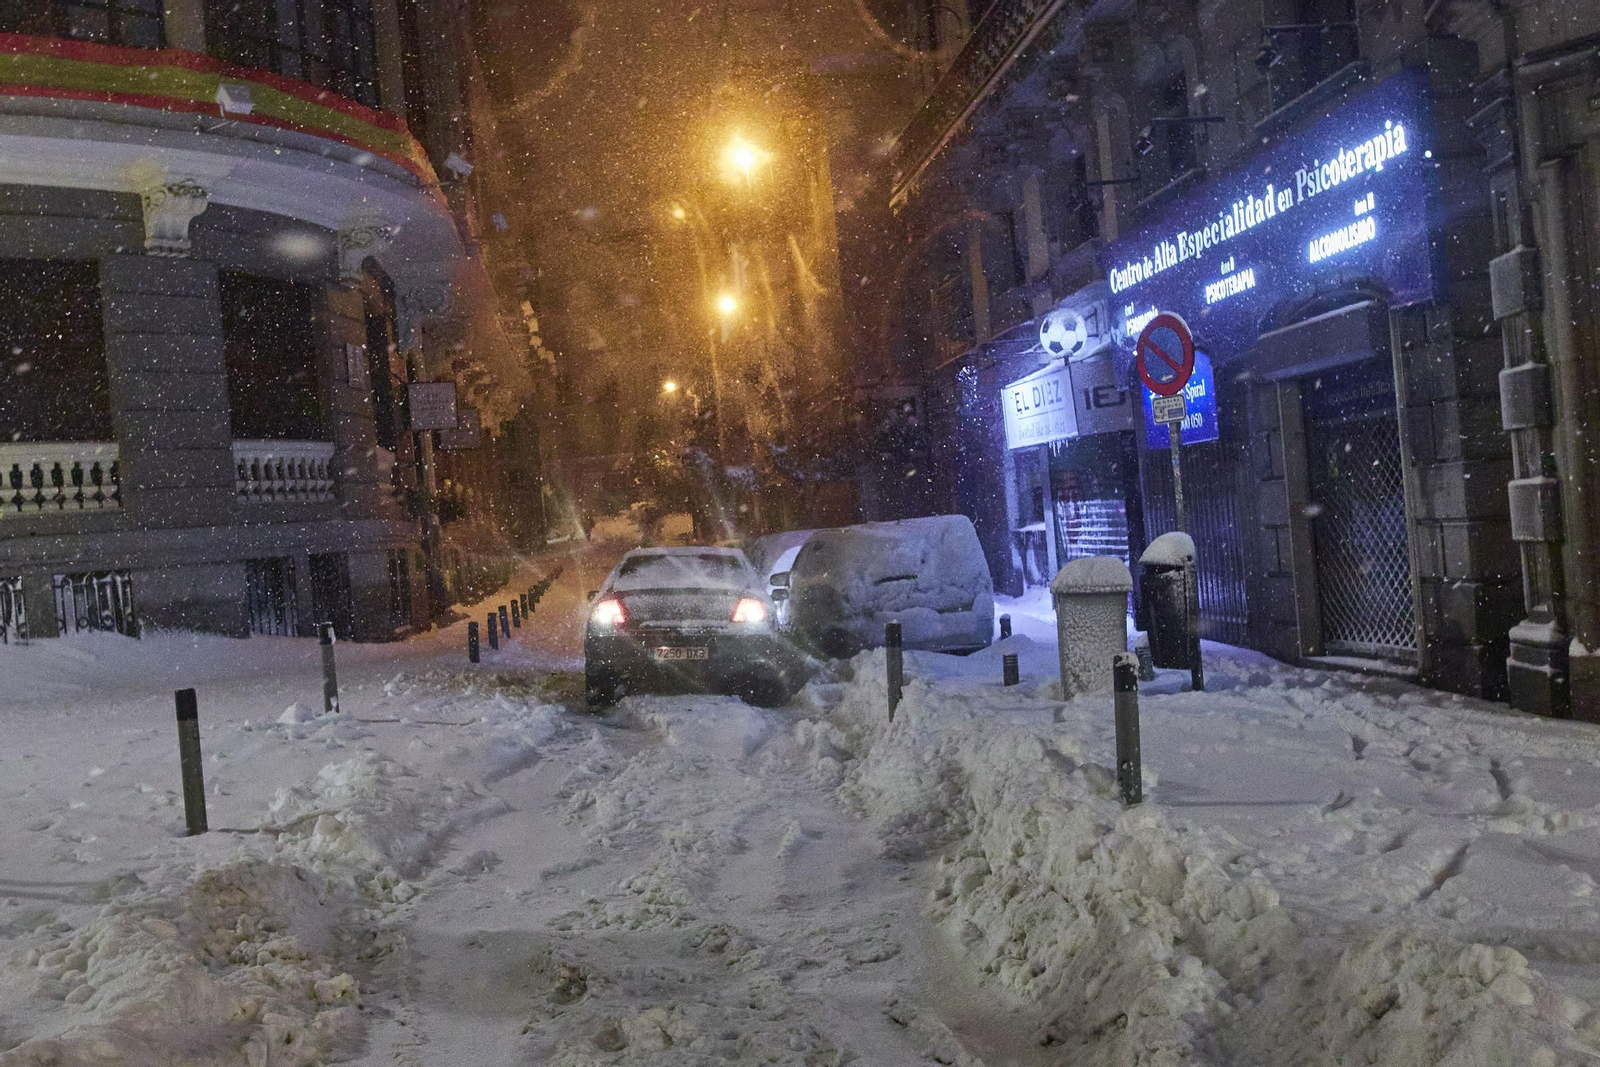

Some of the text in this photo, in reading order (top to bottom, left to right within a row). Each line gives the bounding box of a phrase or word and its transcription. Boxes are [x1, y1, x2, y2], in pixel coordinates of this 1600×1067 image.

[1110, 120, 1407, 294] Centro de Alta Especialidad en Psicoterapia
[1309, 216, 1375, 264] ALCOHOLISMO
[1205, 267, 1256, 304] PSICOTERAPIA
[1014, 390, 1030, 413] EL
[1185, 378, 1206, 403] Spiral
[1191, 413, 1203, 428] 050
[657, 648, 681, 659] 7250
